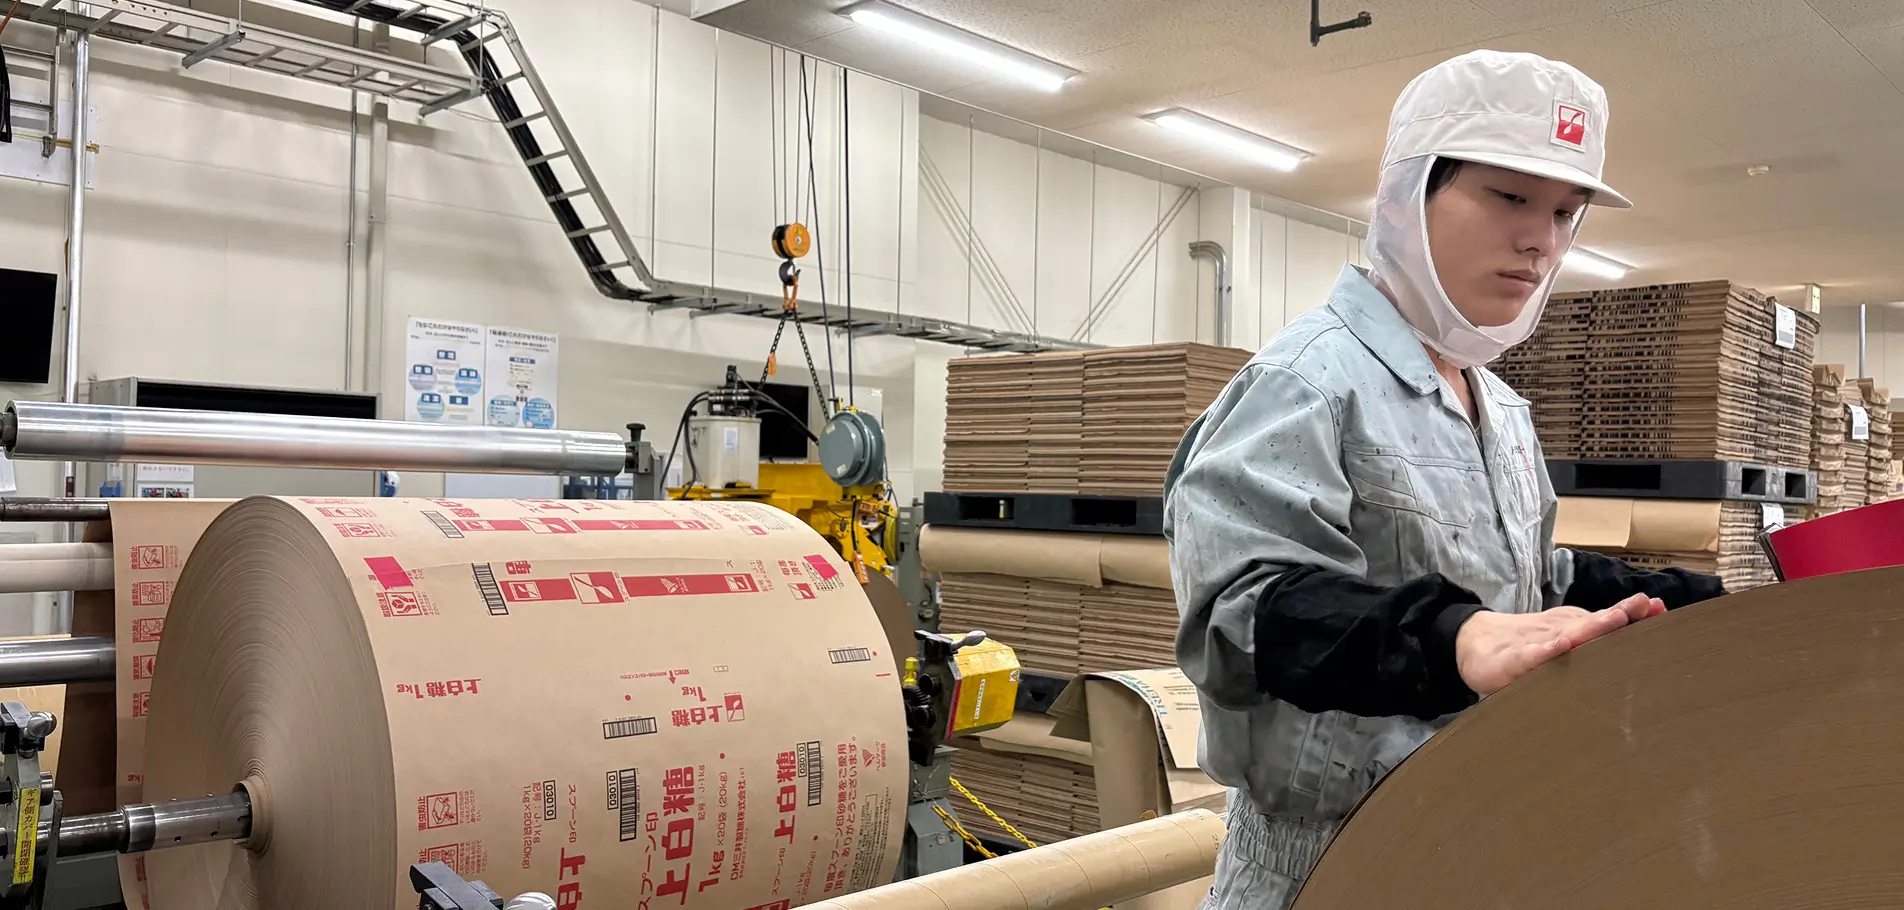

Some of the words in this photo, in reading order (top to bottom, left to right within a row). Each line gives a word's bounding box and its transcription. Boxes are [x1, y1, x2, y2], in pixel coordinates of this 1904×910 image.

[681, 686, 706, 703] 1kg
[671, 705, 723, 728] 上白糖
[798, 745, 806, 774] 03010
[545, 784, 554, 817] 03010
[608, 774, 617, 805] 03010
[774, 750, 797, 845] 上白糖
[568, 784, 578, 843] スプーン印
[656, 765, 695, 905] 上白糖
[638, 812, 659, 910] スプーン印
[698, 850, 725, 892] 1kg
